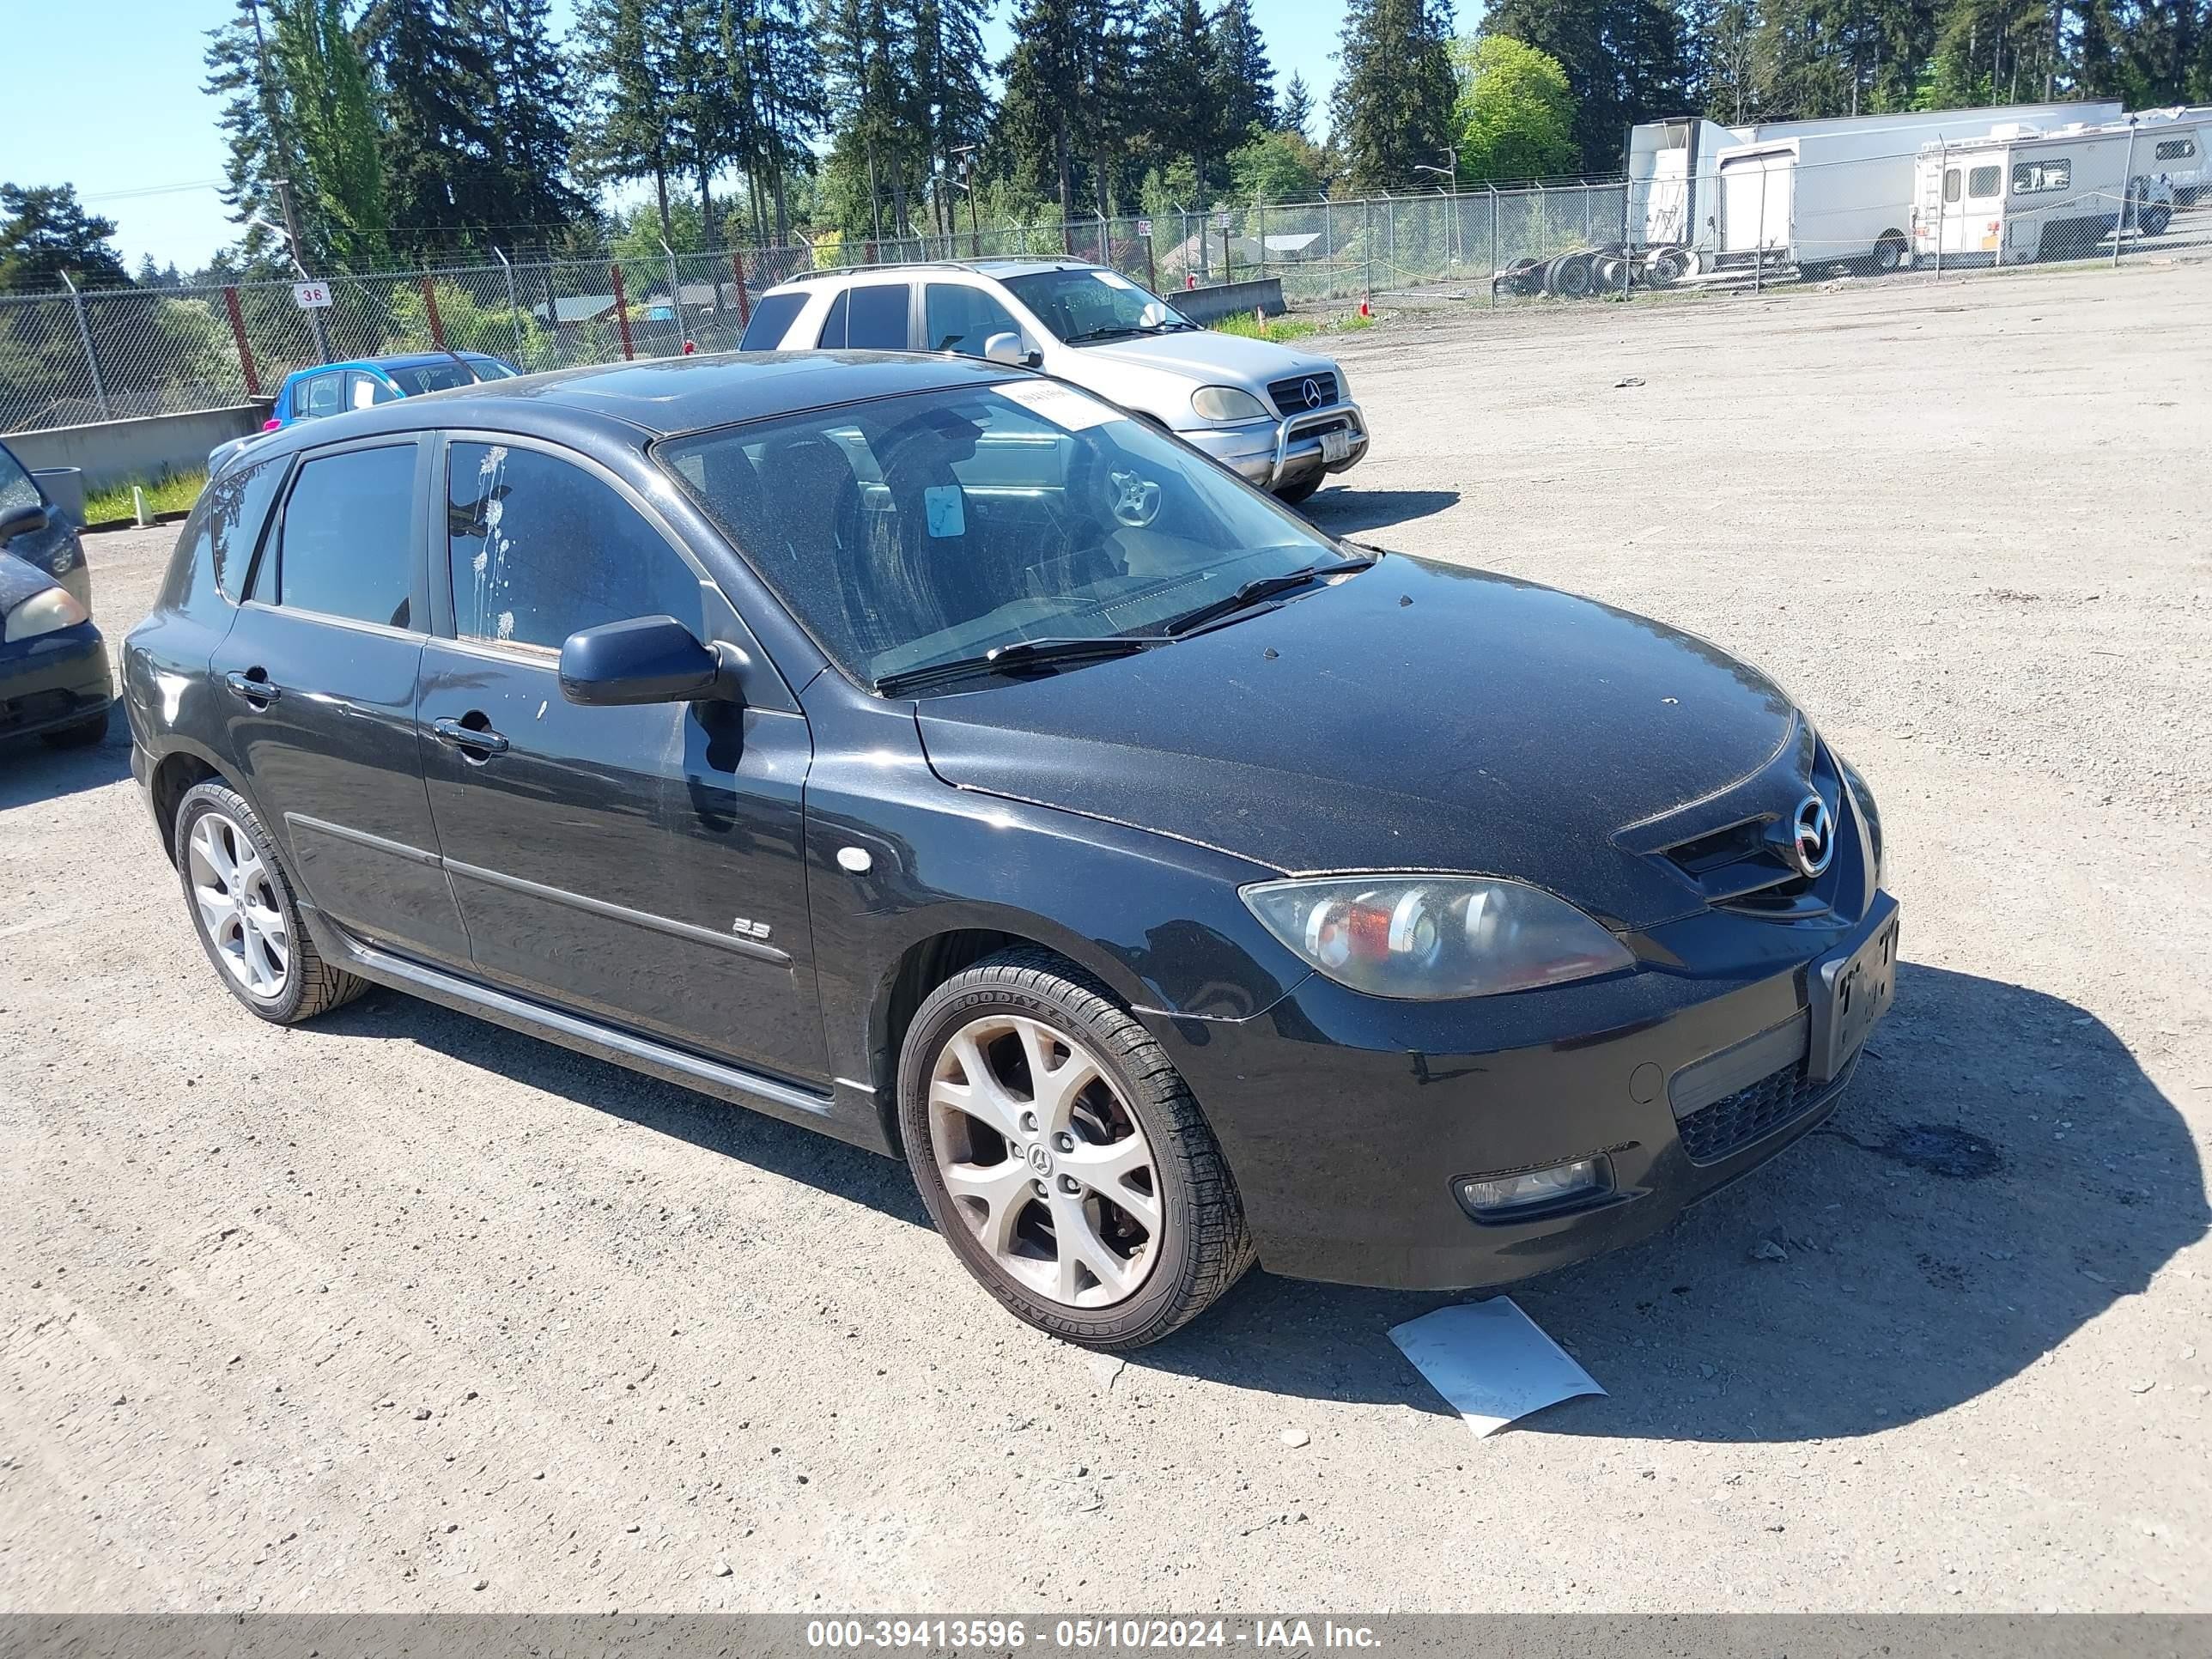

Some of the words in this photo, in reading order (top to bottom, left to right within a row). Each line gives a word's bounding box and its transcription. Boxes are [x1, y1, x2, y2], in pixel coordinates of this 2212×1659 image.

[303, 289, 323, 302] 36
[952, 991, 1088, 1038] GOODYEAR
[982, 1274, 1124, 1335] ASSURANCE
